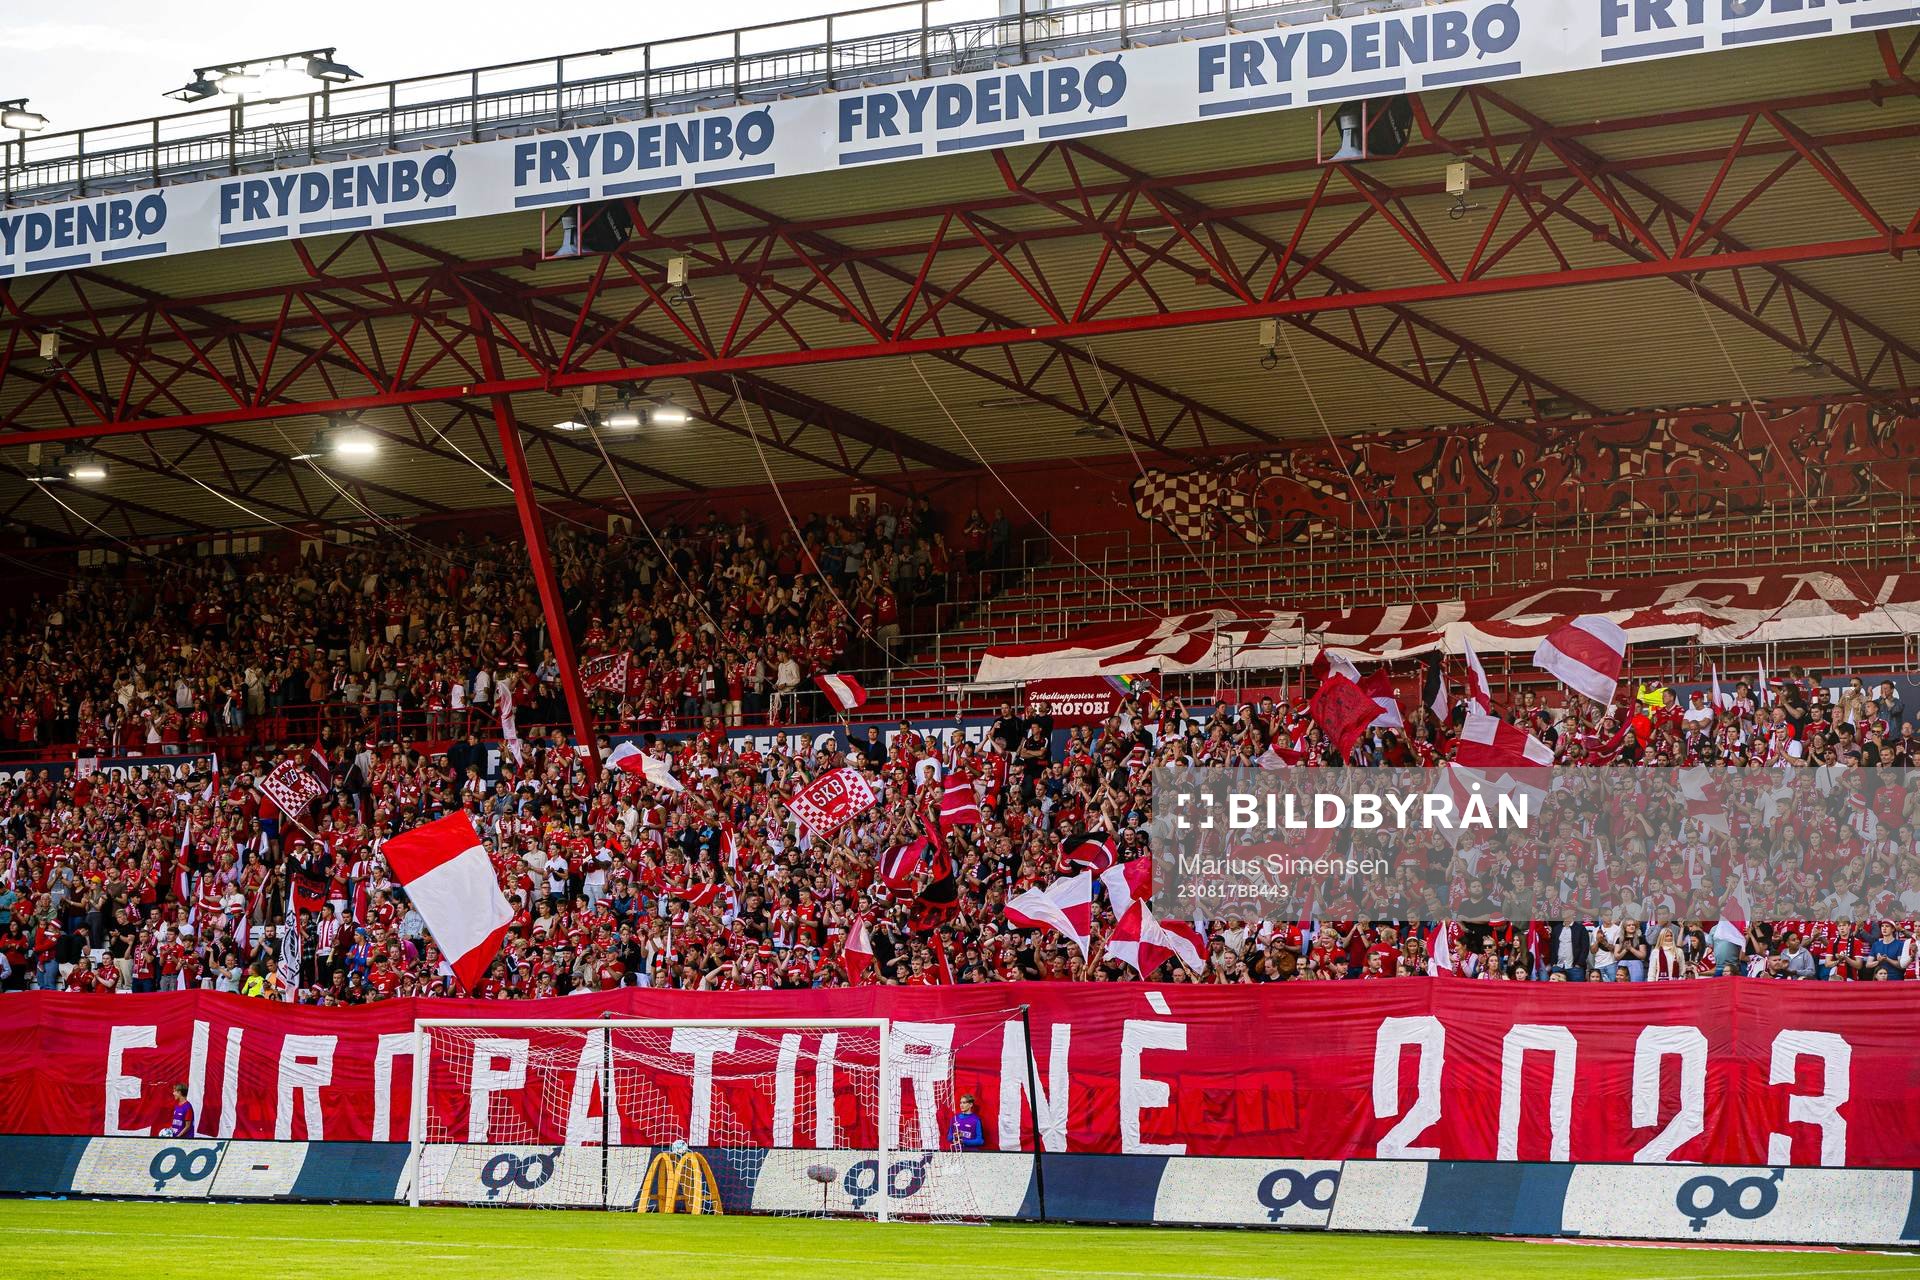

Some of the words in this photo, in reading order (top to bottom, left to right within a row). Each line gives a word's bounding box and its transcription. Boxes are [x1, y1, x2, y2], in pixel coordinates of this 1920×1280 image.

[1199, 0, 1520, 93] FRYDENBØ
[839, 54, 1127, 144] FRYDENBØ
[515, 105, 775, 188] FRYDENBØ
[220, 149, 456, 225] FRYDENBØ
[1030, 701, 1110, 716] HMOFOBI
[1096, 691, 1112, 699] mot
[812, 779, 844, 807] SKB
[1372, 1015, 1852, 1167] 2023
